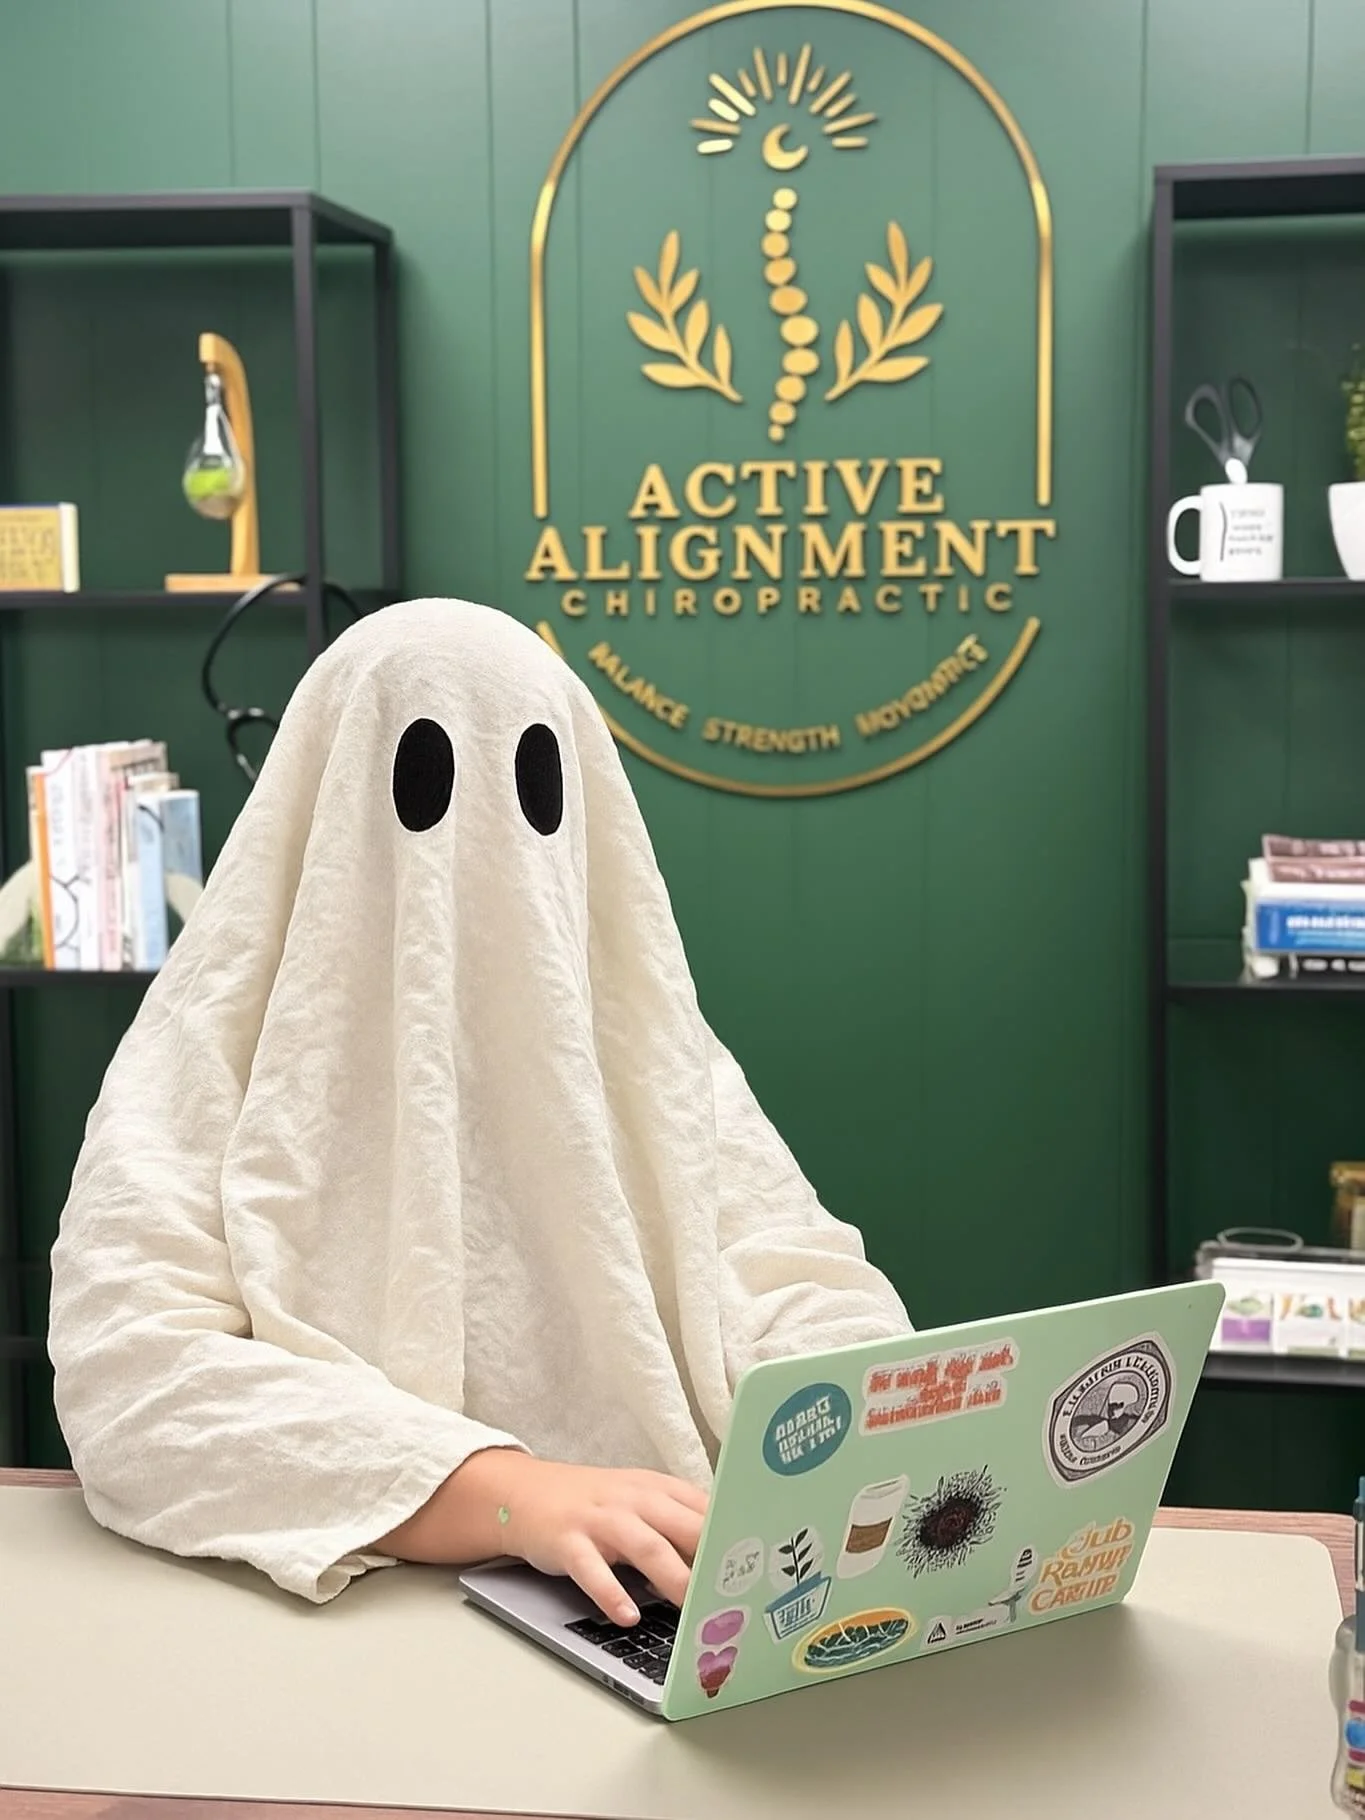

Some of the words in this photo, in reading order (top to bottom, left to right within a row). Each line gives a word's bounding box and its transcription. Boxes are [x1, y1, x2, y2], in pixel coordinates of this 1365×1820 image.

[628, 457, 944, 519] ACTIVE
[525, 519, 1057, 582] ALIGNMENT
[561, 583, 1014, 617] CHIROPRACTIC
[702, 716, 841, 753] STRENGTH
